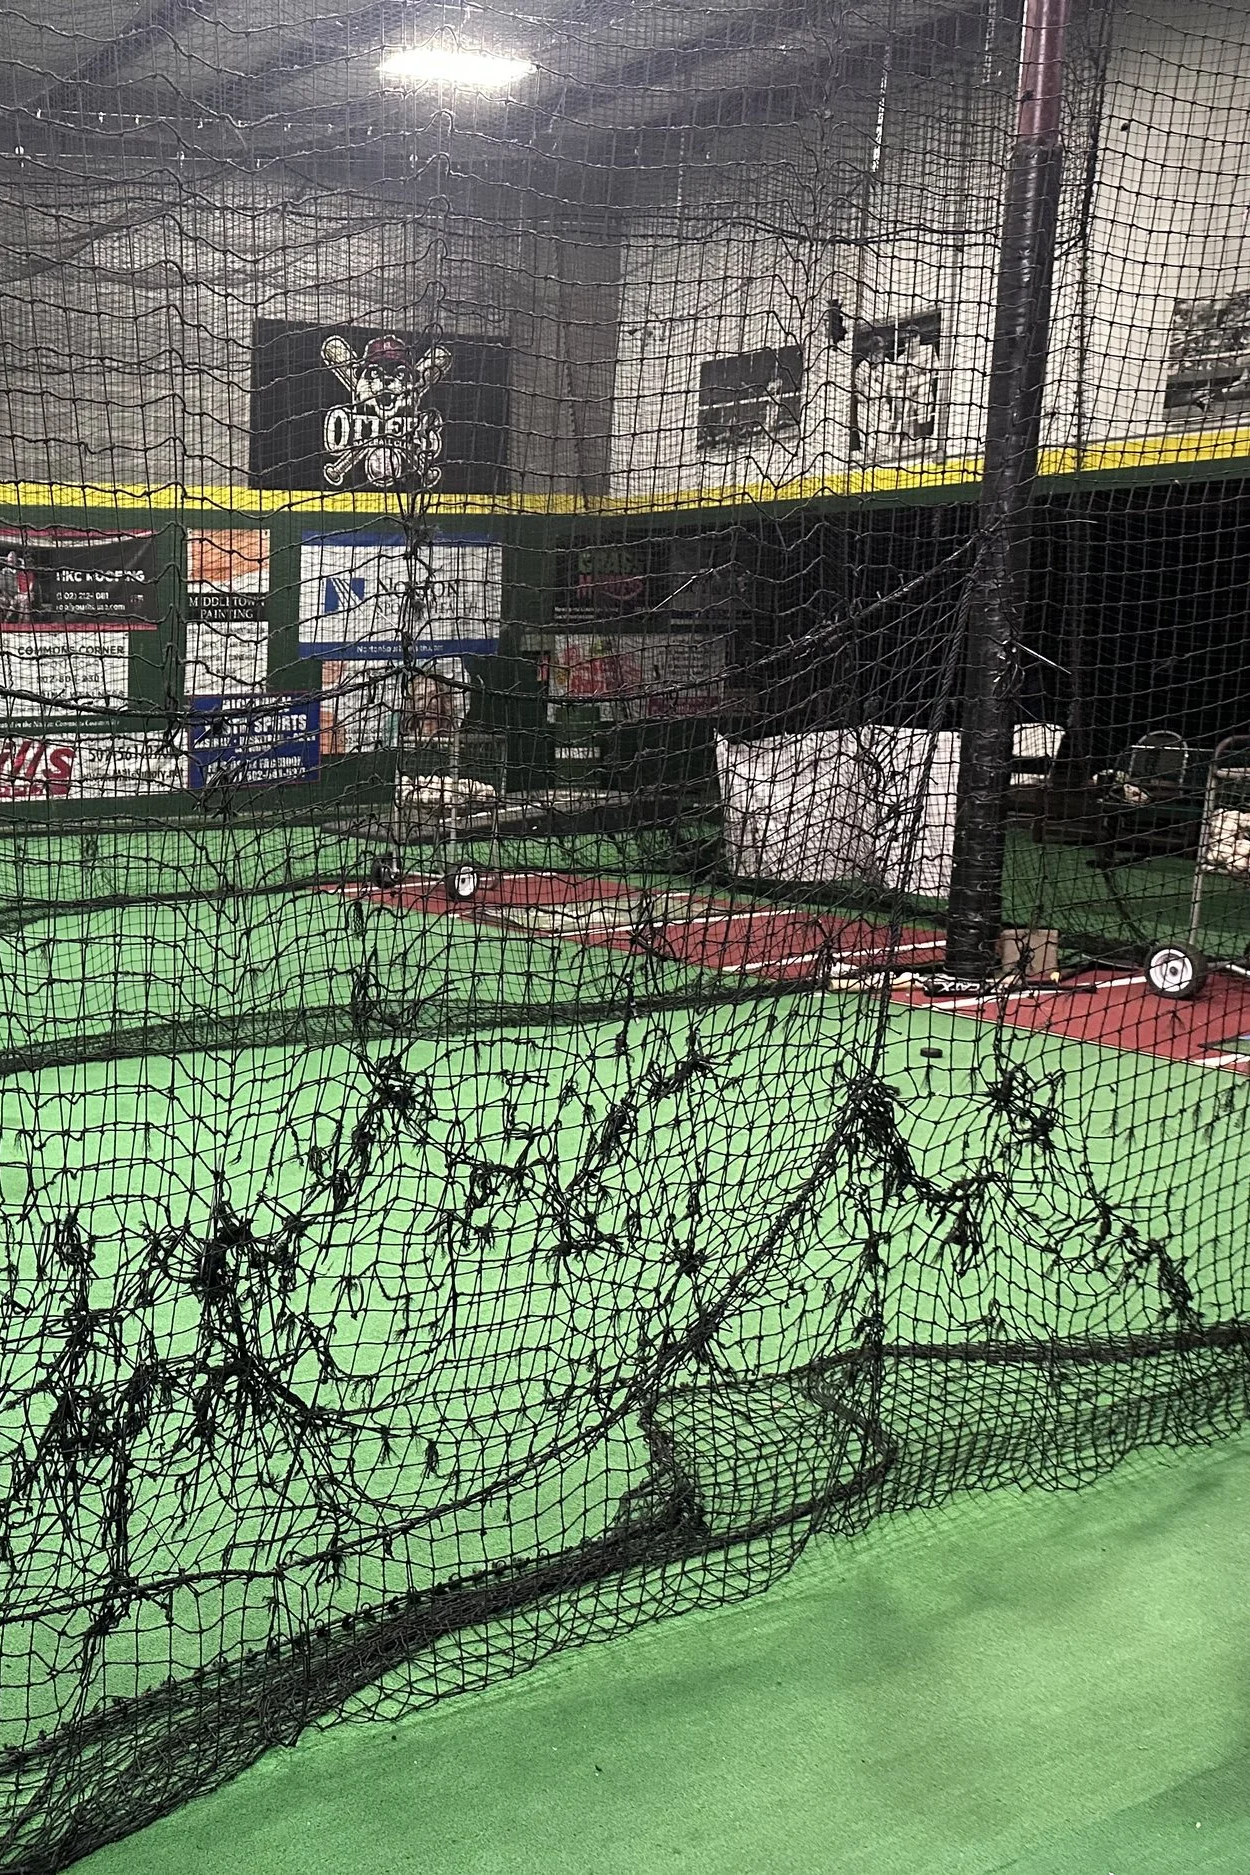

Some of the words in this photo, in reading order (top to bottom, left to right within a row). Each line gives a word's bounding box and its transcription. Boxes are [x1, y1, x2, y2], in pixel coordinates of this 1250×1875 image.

[200, 609, 254, 619] PAINTING
[17, 645, 75, 656] COMMONS
[77, 645, 125, 655] CORNER
[253, 714, 308, 733] SPORTS
